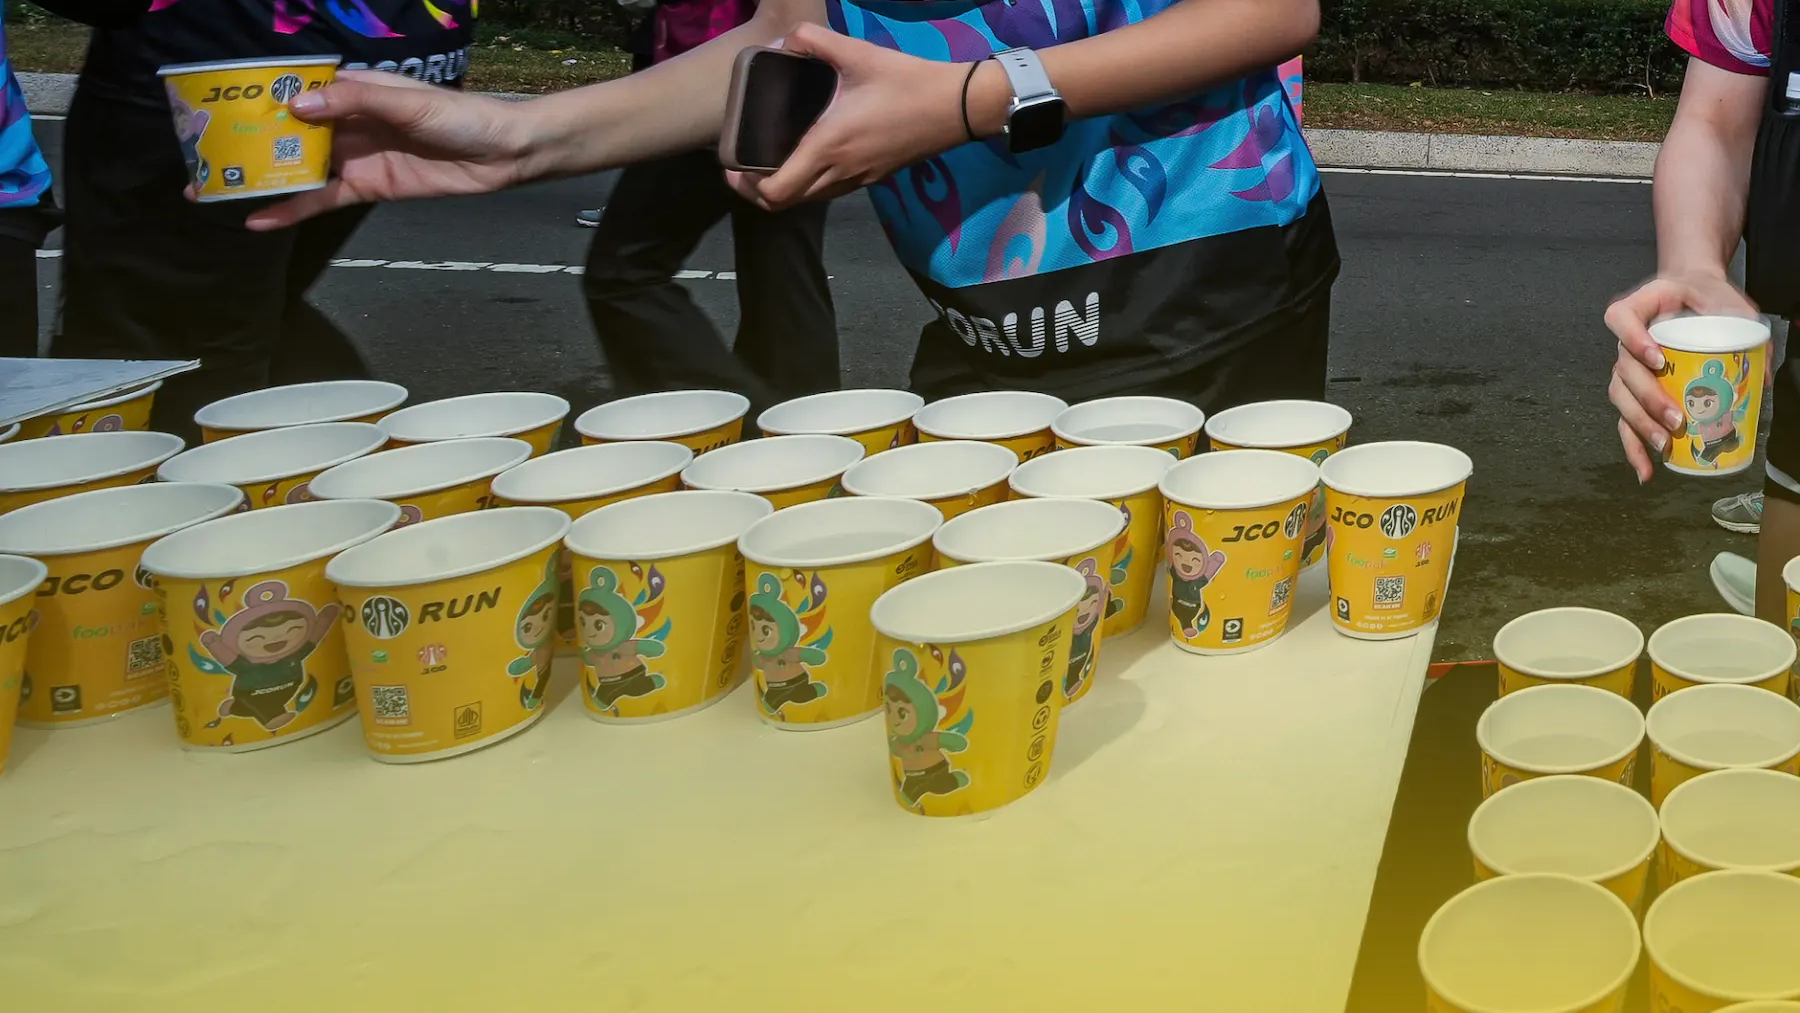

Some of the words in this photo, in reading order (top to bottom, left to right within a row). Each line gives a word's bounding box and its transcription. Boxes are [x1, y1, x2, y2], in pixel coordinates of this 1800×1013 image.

[201, 84, 264, 103] JCO
[930, 291, 1101, 358] ORUN
[1331, 506, 1374, 529] JCO
[1420, 496, 1459, 527] RUN
[1221, 520, 1280, 543] JCO
[36, 568, 124, 598] JCO
[417, 586, 503, 625] RUN
